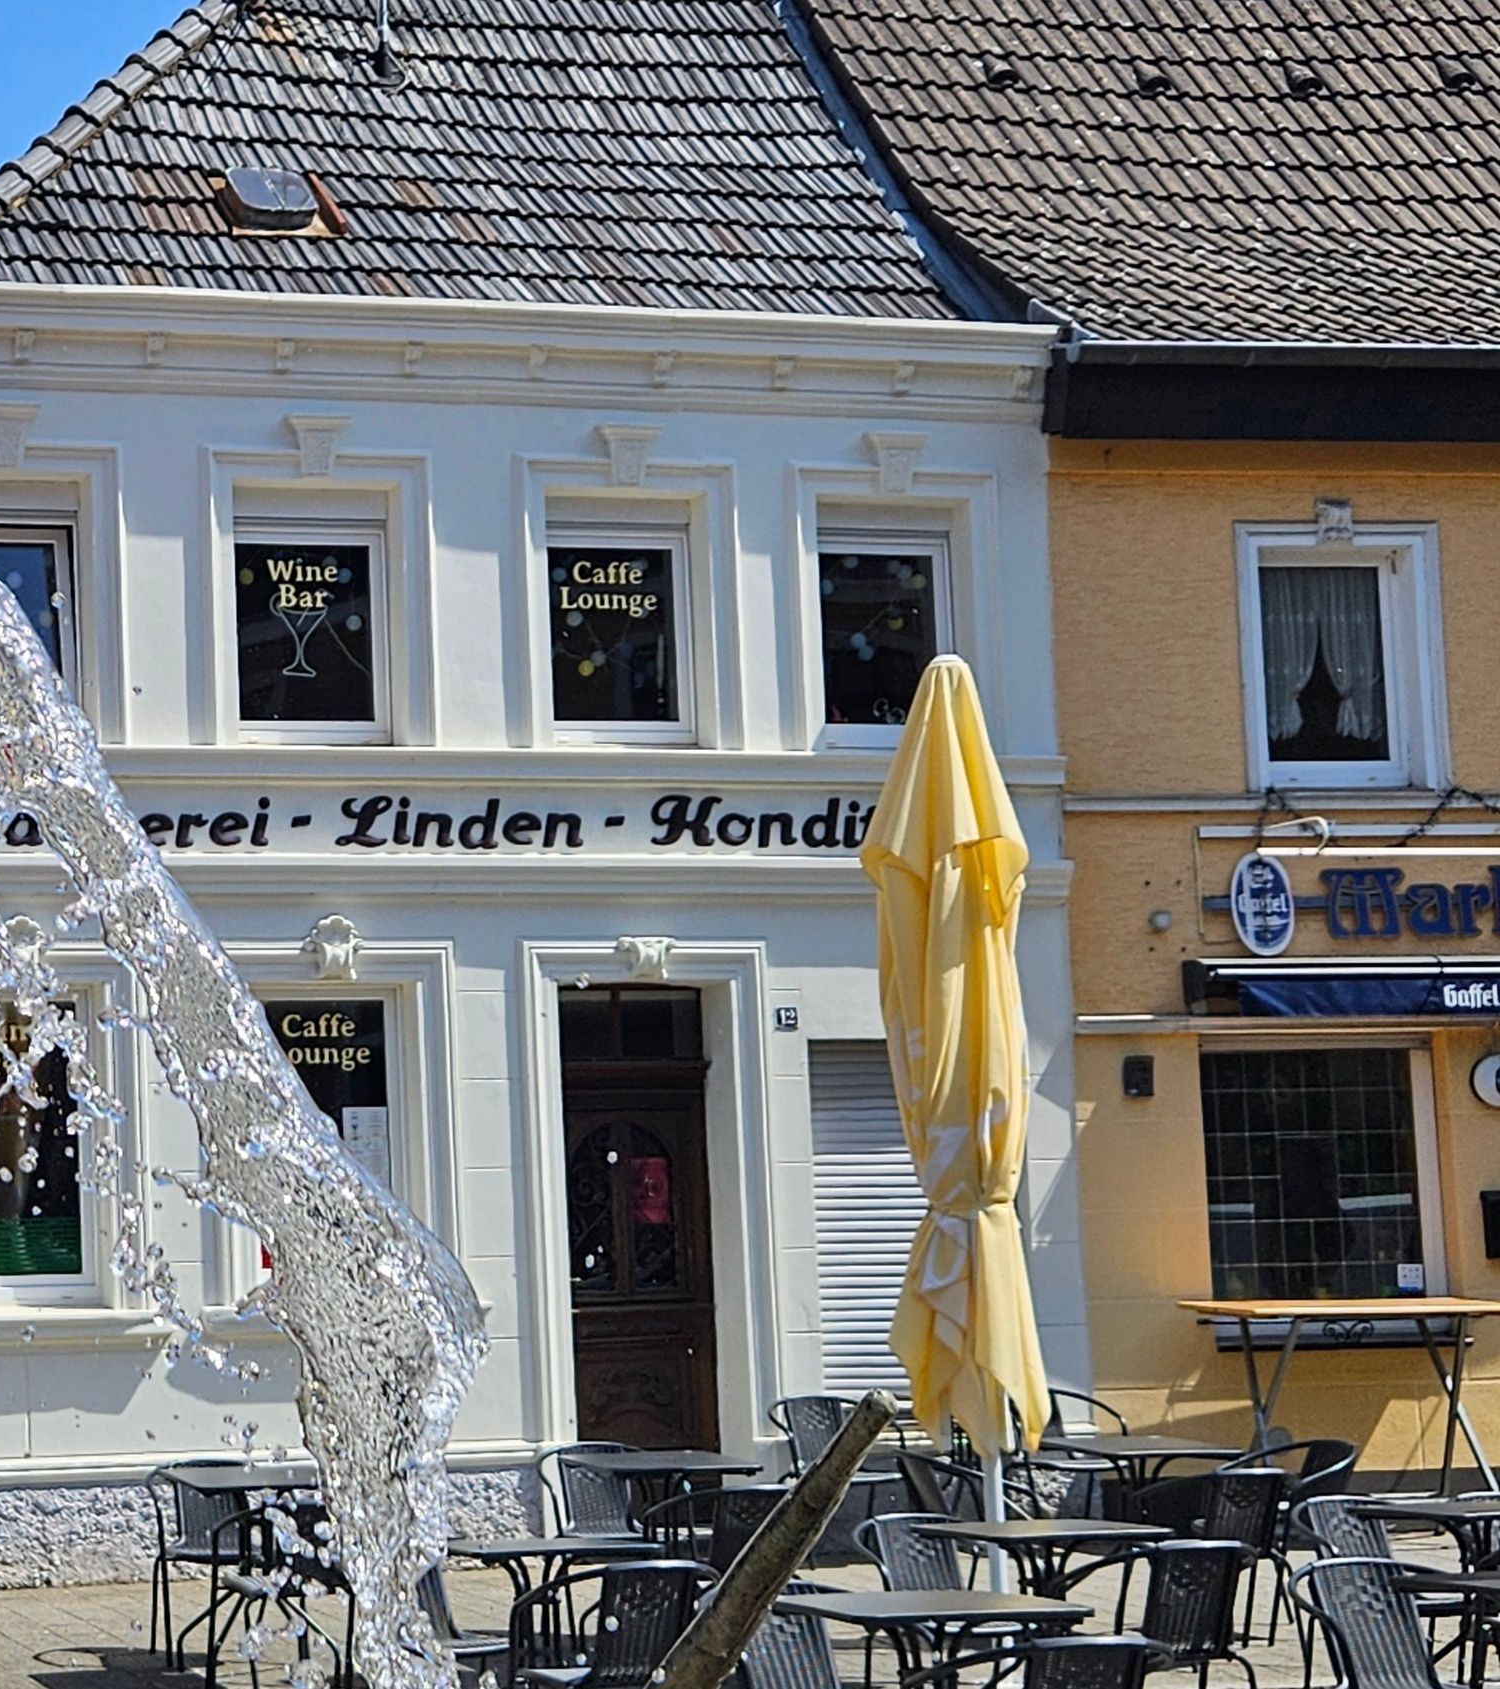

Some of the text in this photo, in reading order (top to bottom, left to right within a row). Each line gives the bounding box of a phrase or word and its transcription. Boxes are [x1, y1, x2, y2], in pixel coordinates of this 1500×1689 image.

[266, 558, 339, 584] Wine
[278, 583, 329, 608] Bar
[559, 586, 658, 618] Lounge
[335, 795, 584, 849] Linden
[1319, 865, 1500, 940] Mar
[1442, 983, 1500, 1009] Gaffel
[780, 1009, 797, 1025] 12
[288, 1046, 371, 1072] ounge
